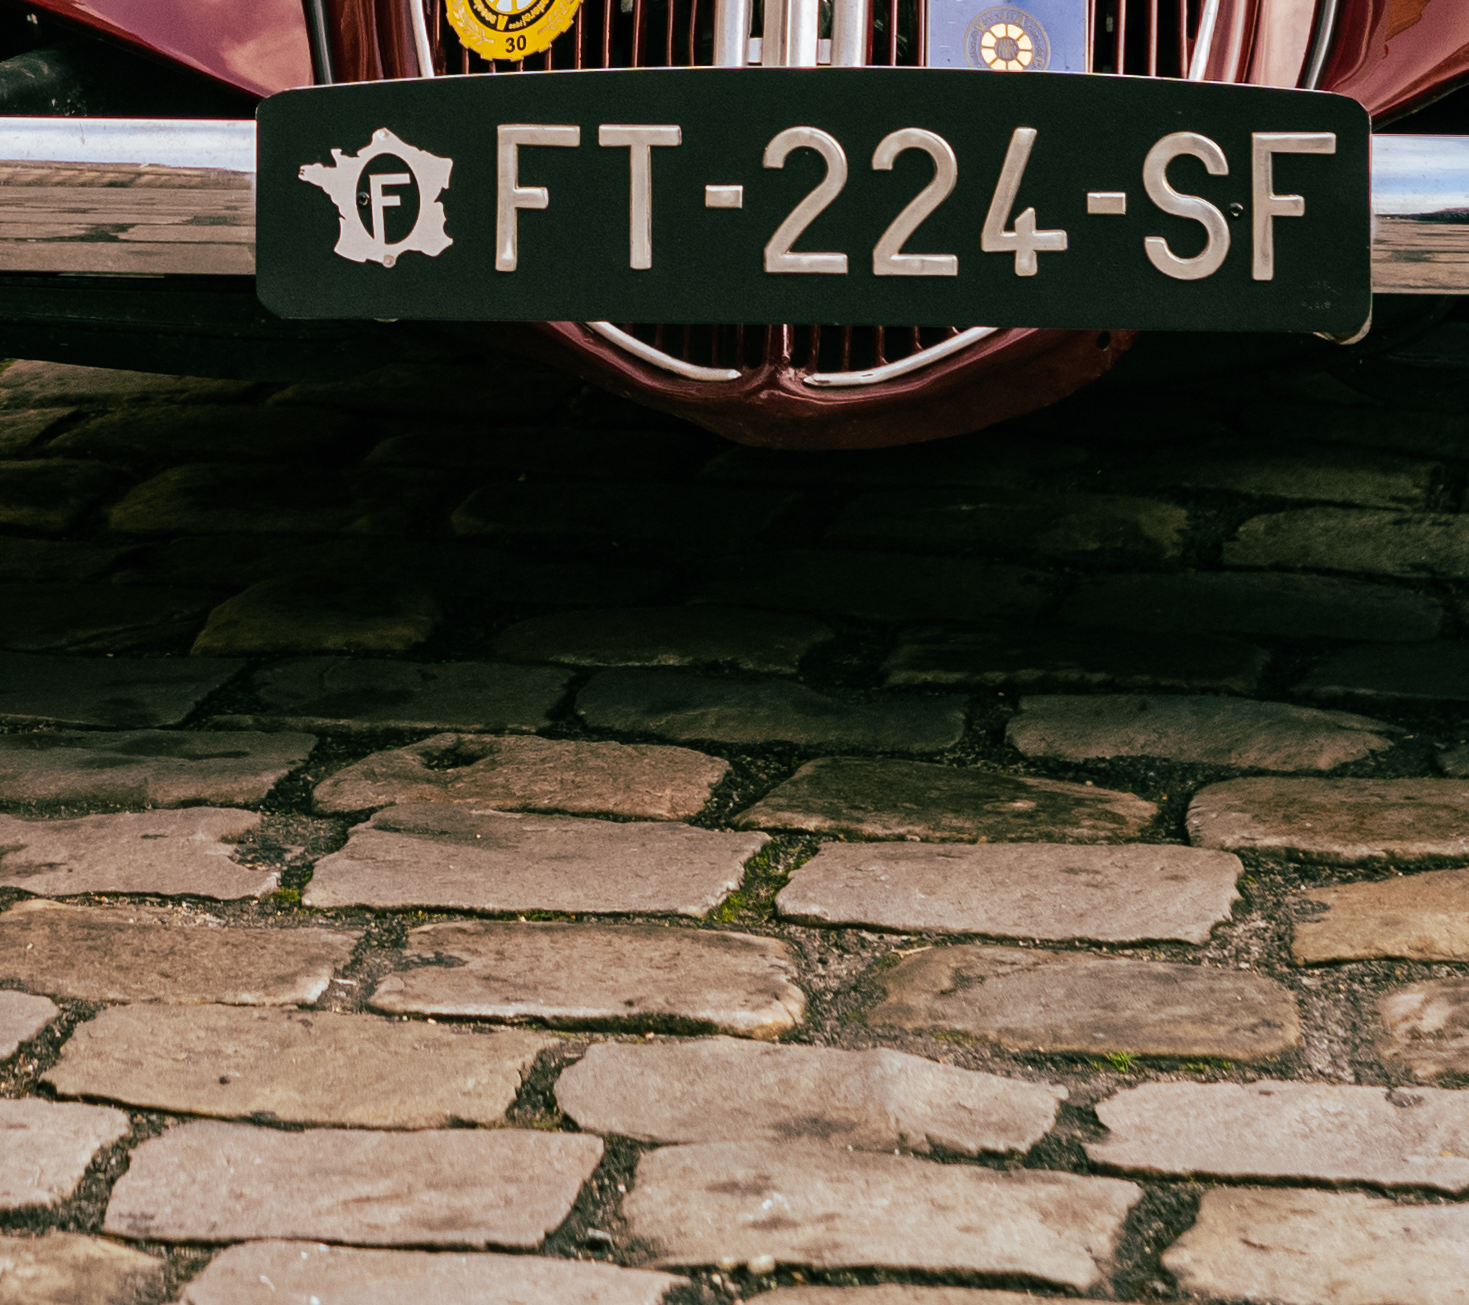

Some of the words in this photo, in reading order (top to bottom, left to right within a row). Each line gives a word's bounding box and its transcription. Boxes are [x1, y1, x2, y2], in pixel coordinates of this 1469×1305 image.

[505, 35, 527, 53] 30
[368, 172, 413, 247] F
[494, 123, 1338, 281] FT-224-SF
